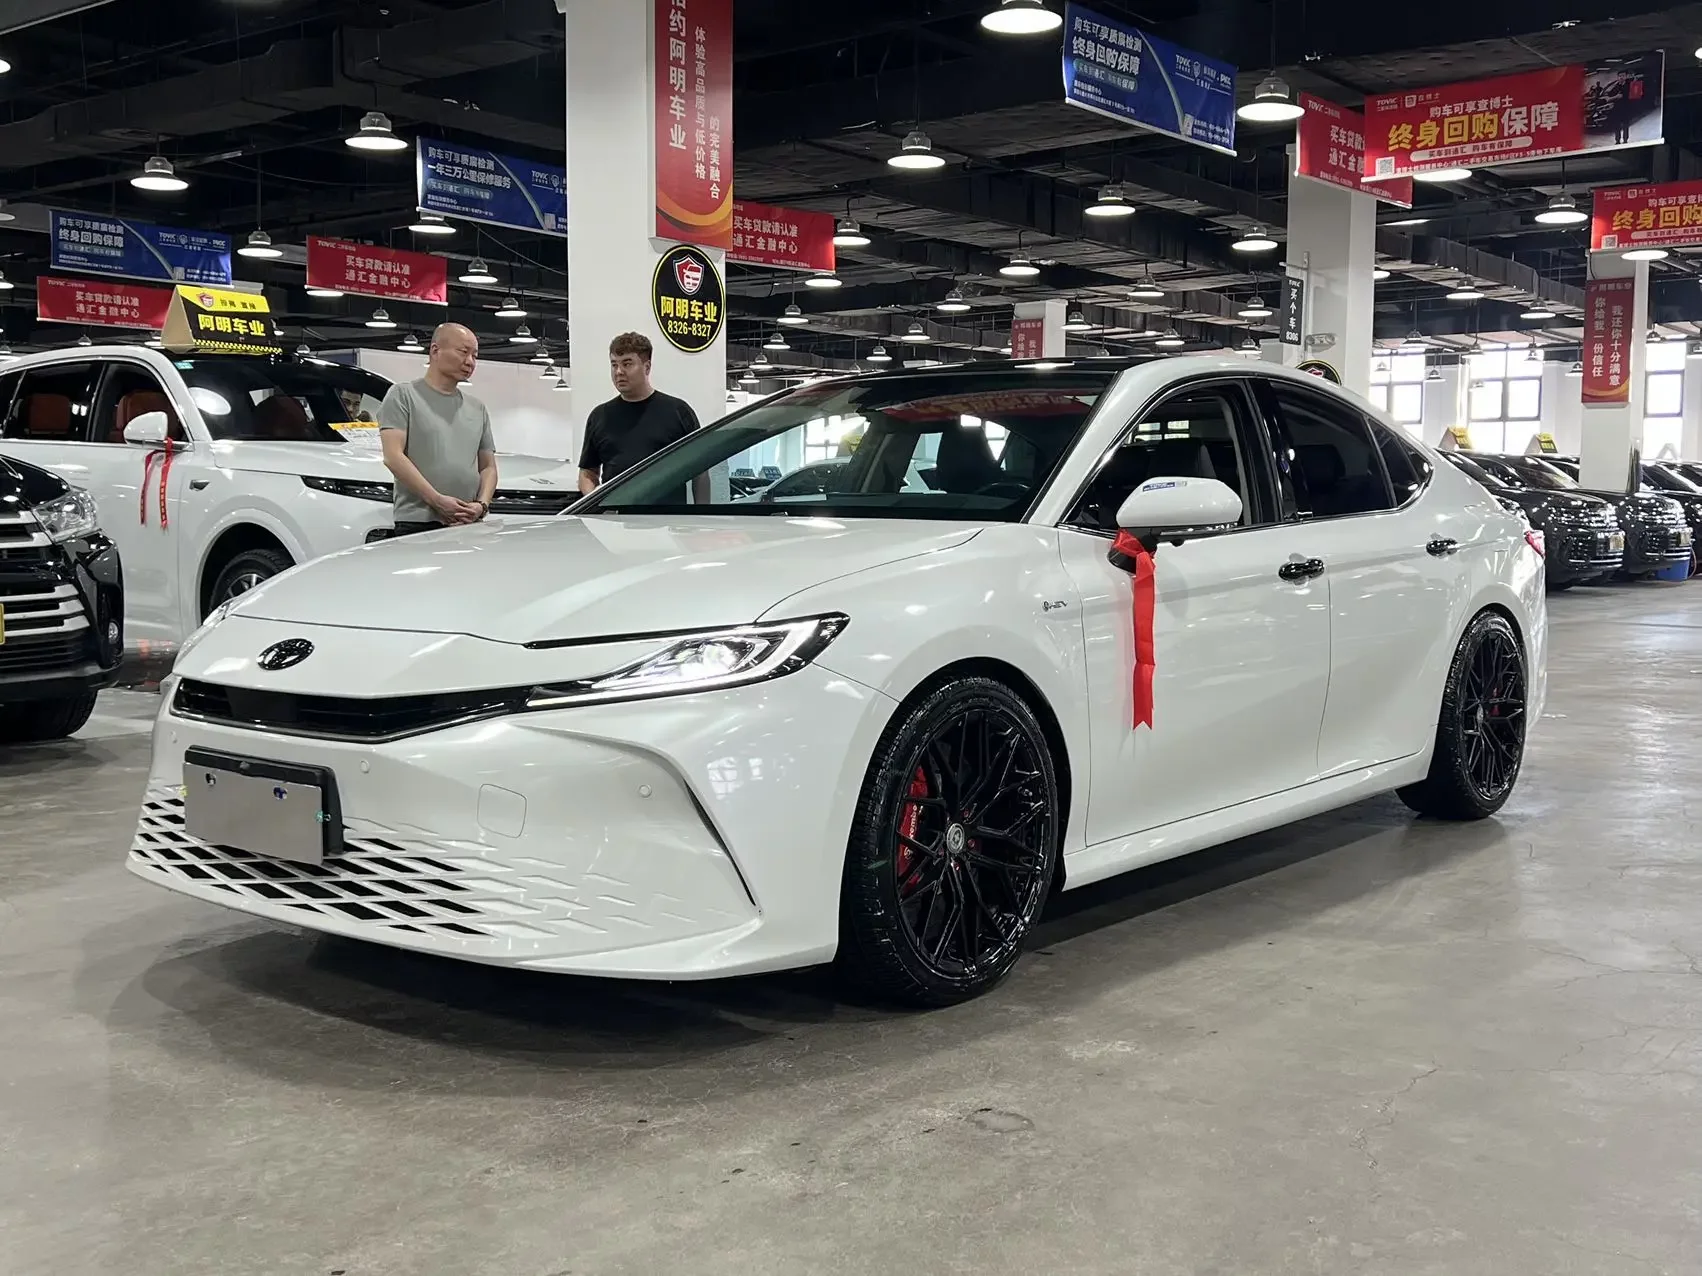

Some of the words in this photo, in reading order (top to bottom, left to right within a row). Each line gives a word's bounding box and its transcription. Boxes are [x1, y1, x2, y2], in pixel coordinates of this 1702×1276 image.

[1072, 35, 1141, 76] 终身回购保障
[694, 26, 706, 180] 体验高品质与低价格
[1429, 94, 1514, 119] 购车可享查博士
[1330, 125, 1365, 151] 买车贷款
[1388, 101, 1559, 152] 终身回购保障
[709, 115, 721, 200] 的完美融合
[58, 228, 124, 248] 终身回购保障
[734, 215, 799, 238] 买车贷款请认准
[733, 233, 799, 255] 通汇金融中心
[345, 255, 411, 275] 买车贷款请认准
[344, 269, 412, 289] 通汇金融中心
[75, 290, 140, 307] 买车贷款请认准
[76, 303, 140, 318] 通汇金融中心
[660, 295, 718, 323] 阿明车业
[197, 313, 267, 337] 阿明车业
[667, 320, 712, 337] 8326-8327
[1592, 297, 1606, 378] 你给我一份信任
[1608, 305, 1624, 386] 我还你十分满意
